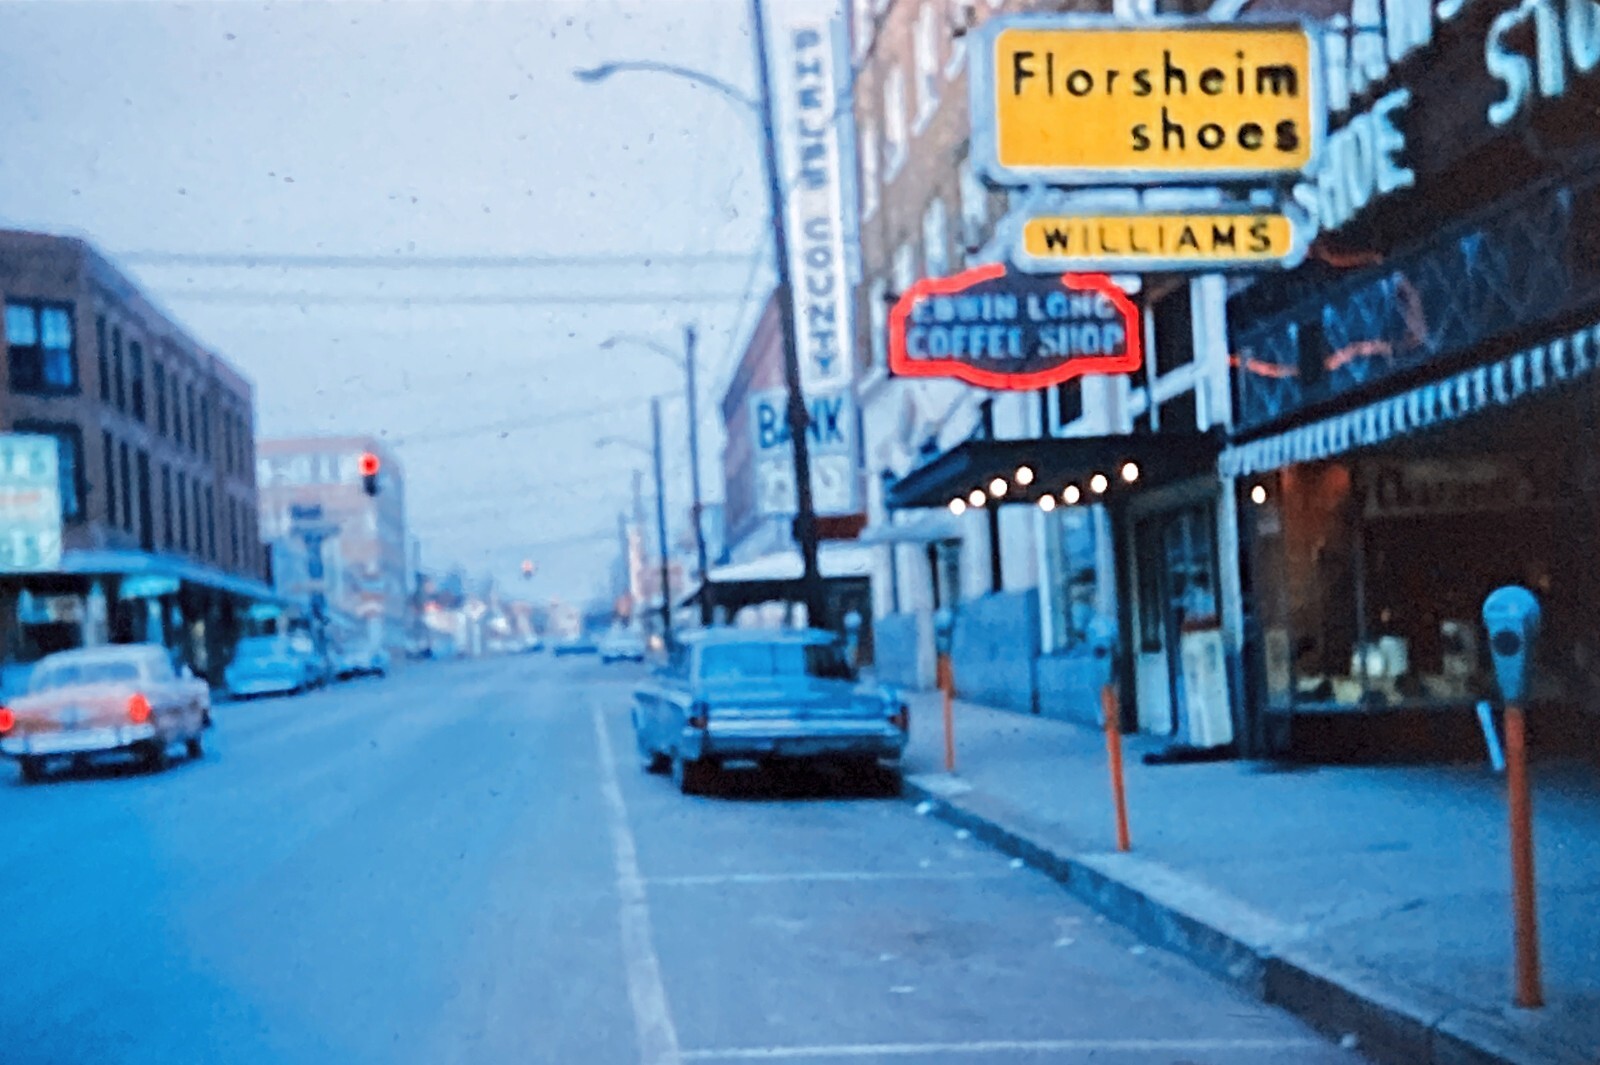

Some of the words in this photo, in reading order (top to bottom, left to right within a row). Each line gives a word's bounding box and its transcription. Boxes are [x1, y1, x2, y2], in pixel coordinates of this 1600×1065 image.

[1013, 49, 1299, 98] Florsheim
[1130, 105, 1300, 153] shoes
[1042, 217, 1273, 254] WILLIAMS
[803, 216, 838, 375] COUNTY
[906, 325, 1025, 360] COFFEE
[1038, 322, 1126, 358] SHOP
